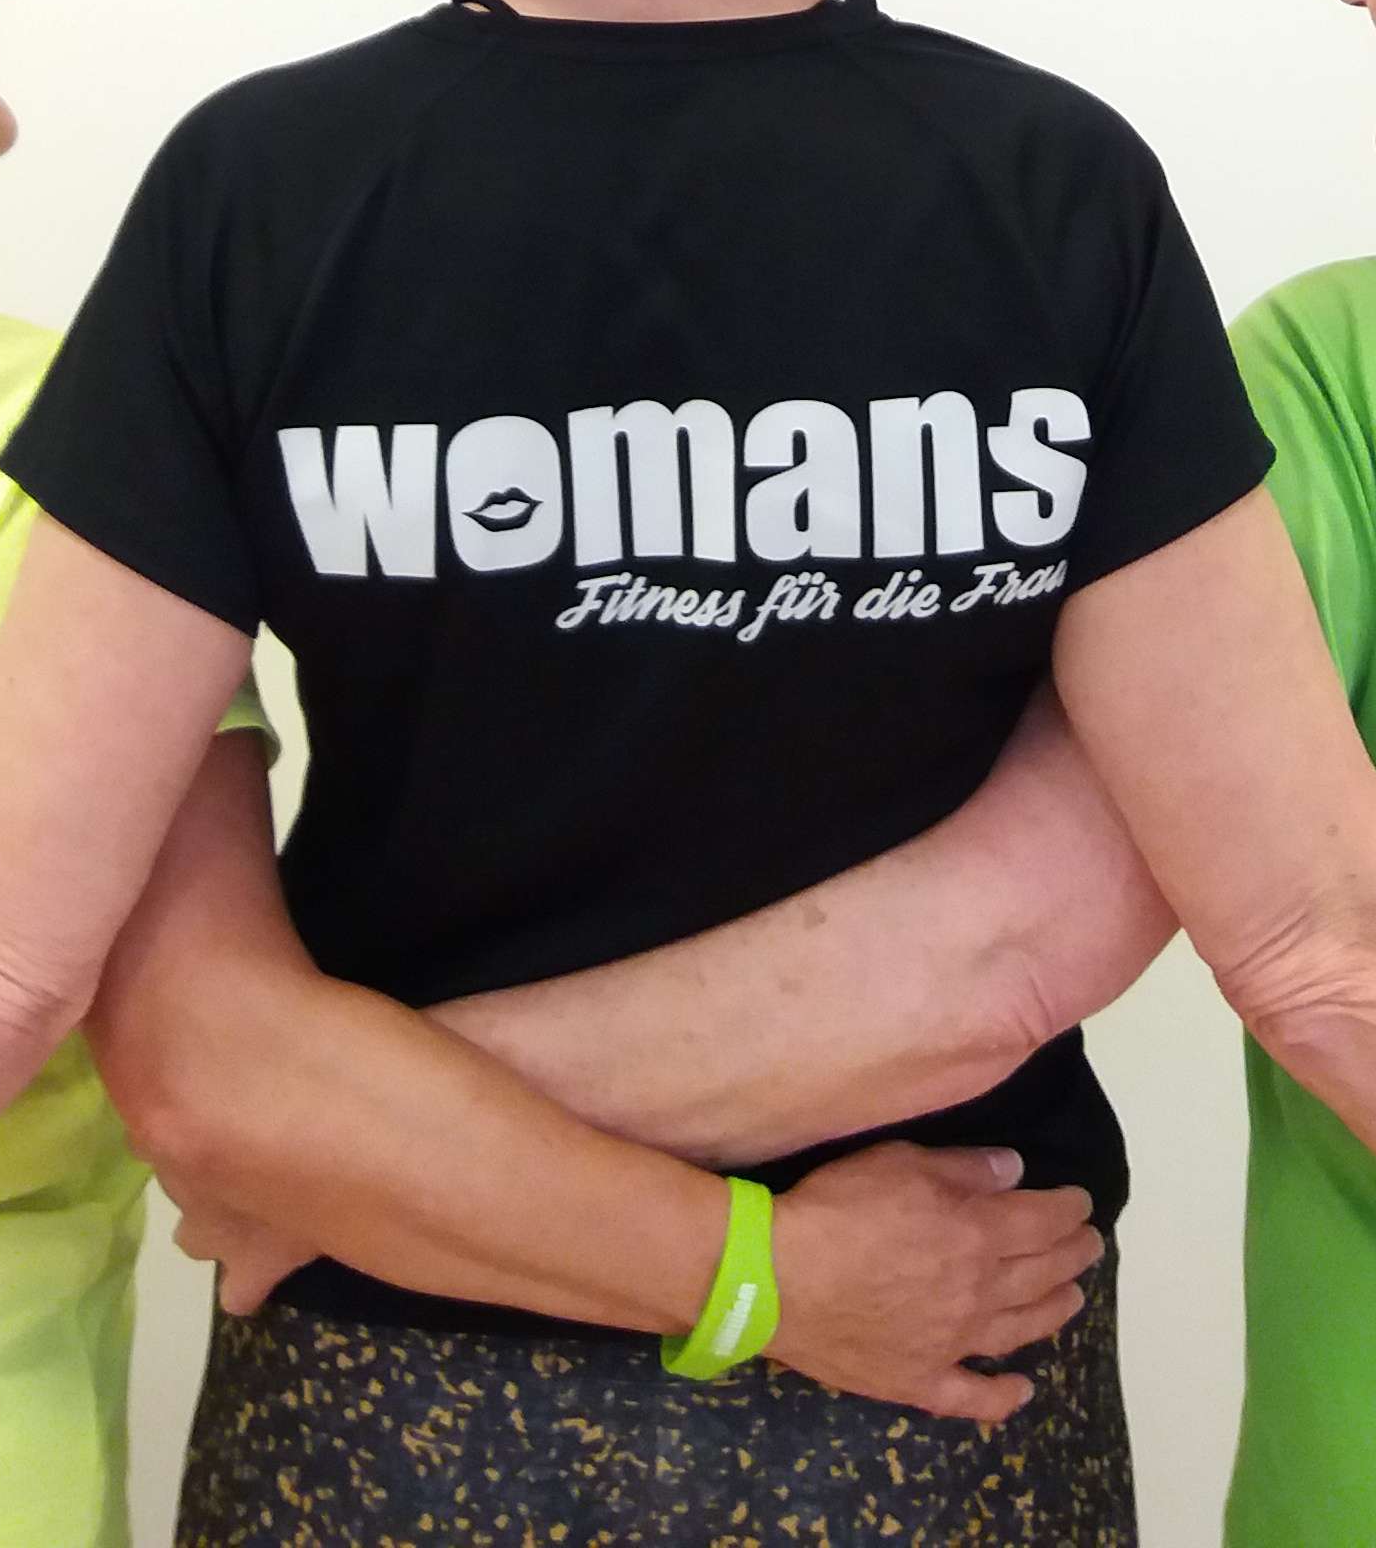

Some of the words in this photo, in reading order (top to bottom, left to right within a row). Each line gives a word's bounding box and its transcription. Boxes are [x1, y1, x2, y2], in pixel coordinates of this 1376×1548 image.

[277, 387, 1092, 579] womans
[556, 572, 746, 629] Fitness
[737, 571, 841, 643] für
[853, 569, 941, 620] die
